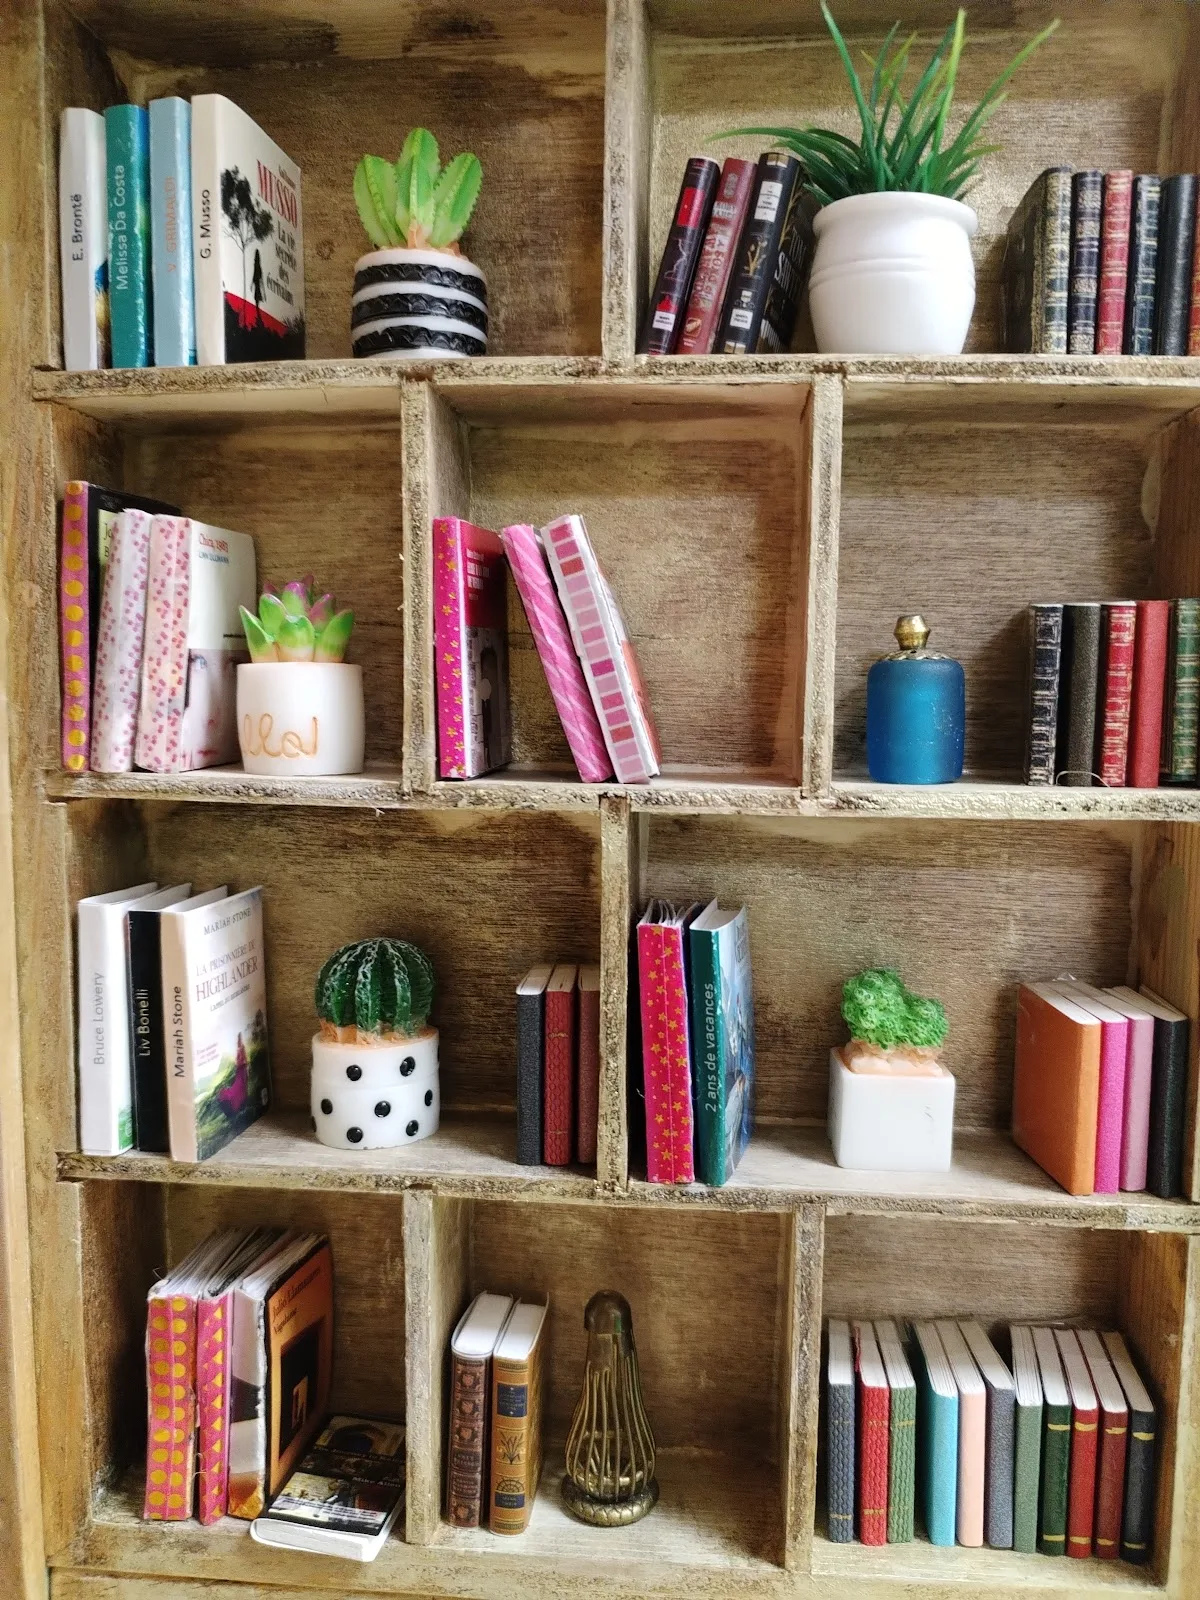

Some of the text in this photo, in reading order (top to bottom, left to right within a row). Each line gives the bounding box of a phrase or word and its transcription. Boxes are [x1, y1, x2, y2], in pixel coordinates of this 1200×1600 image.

[71, 193, 84, 261] E. Brontë
[113, 164, 129, 290] Melissa Da Costa
[200, 189, 212, 259] G. Musso
[257, 159, 298, 229] MUSSO
[204, 907, 252, 936] MARIAH STONE
[196, 956, 258, 1002] HIGHLANDER
[93, 972, 106, 1066] Bruce Lowery
[137, 988, 151, 1057] Liv Bonelli
[172, 985, 186, 1078] Mariah Stone
[703, 983, 717, 1113] 2 ans de vacances
